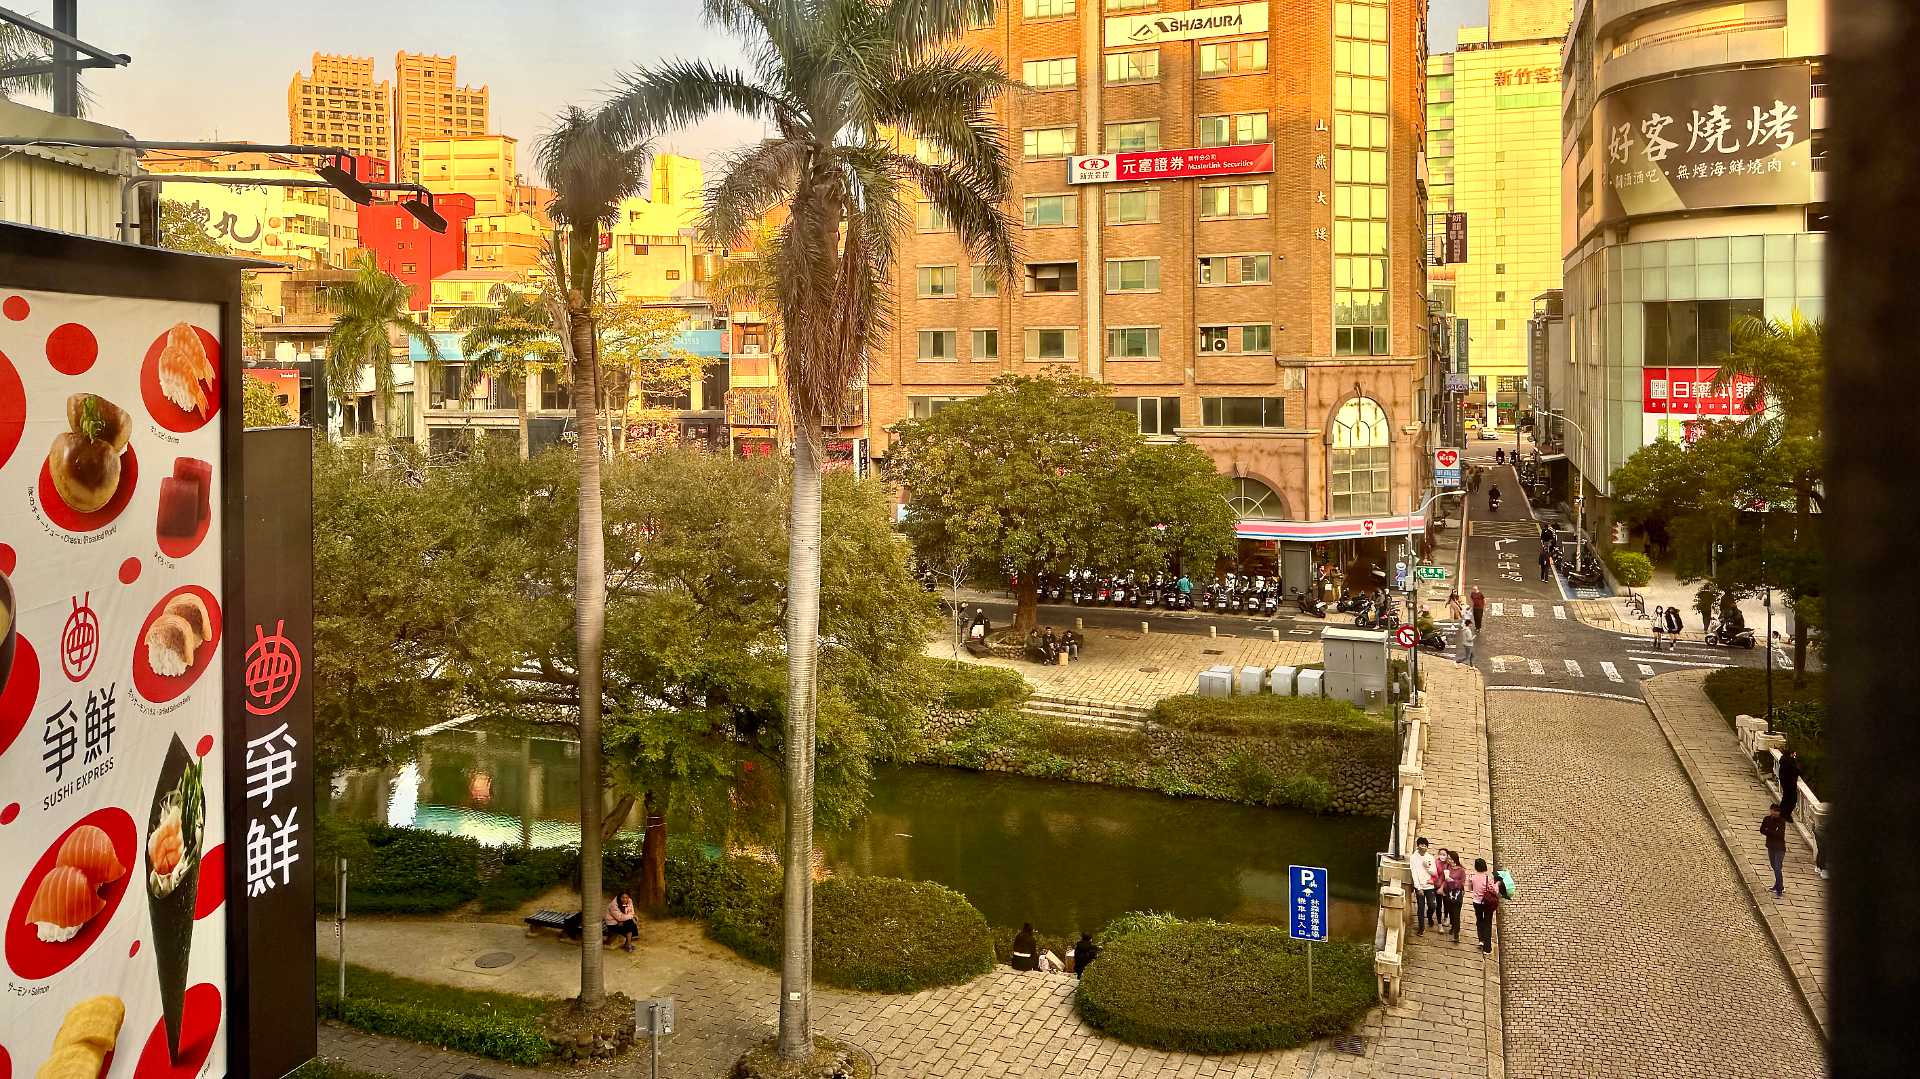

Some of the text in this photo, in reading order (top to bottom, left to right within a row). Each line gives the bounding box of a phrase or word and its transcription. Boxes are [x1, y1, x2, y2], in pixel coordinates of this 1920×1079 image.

[1170, 14, 1243, 32] SHIBAURA
[1608, 99, 1799, 165] 好客燒烤
[1122, 156, 1184, 174] 元富證券
[42, 681, 116, 783] 爭鮮
[76, 756, 114, 792] EXPRESS
[246, 722, 299, 898] 爭鮮
[1301, 870, 1314, 885] P
